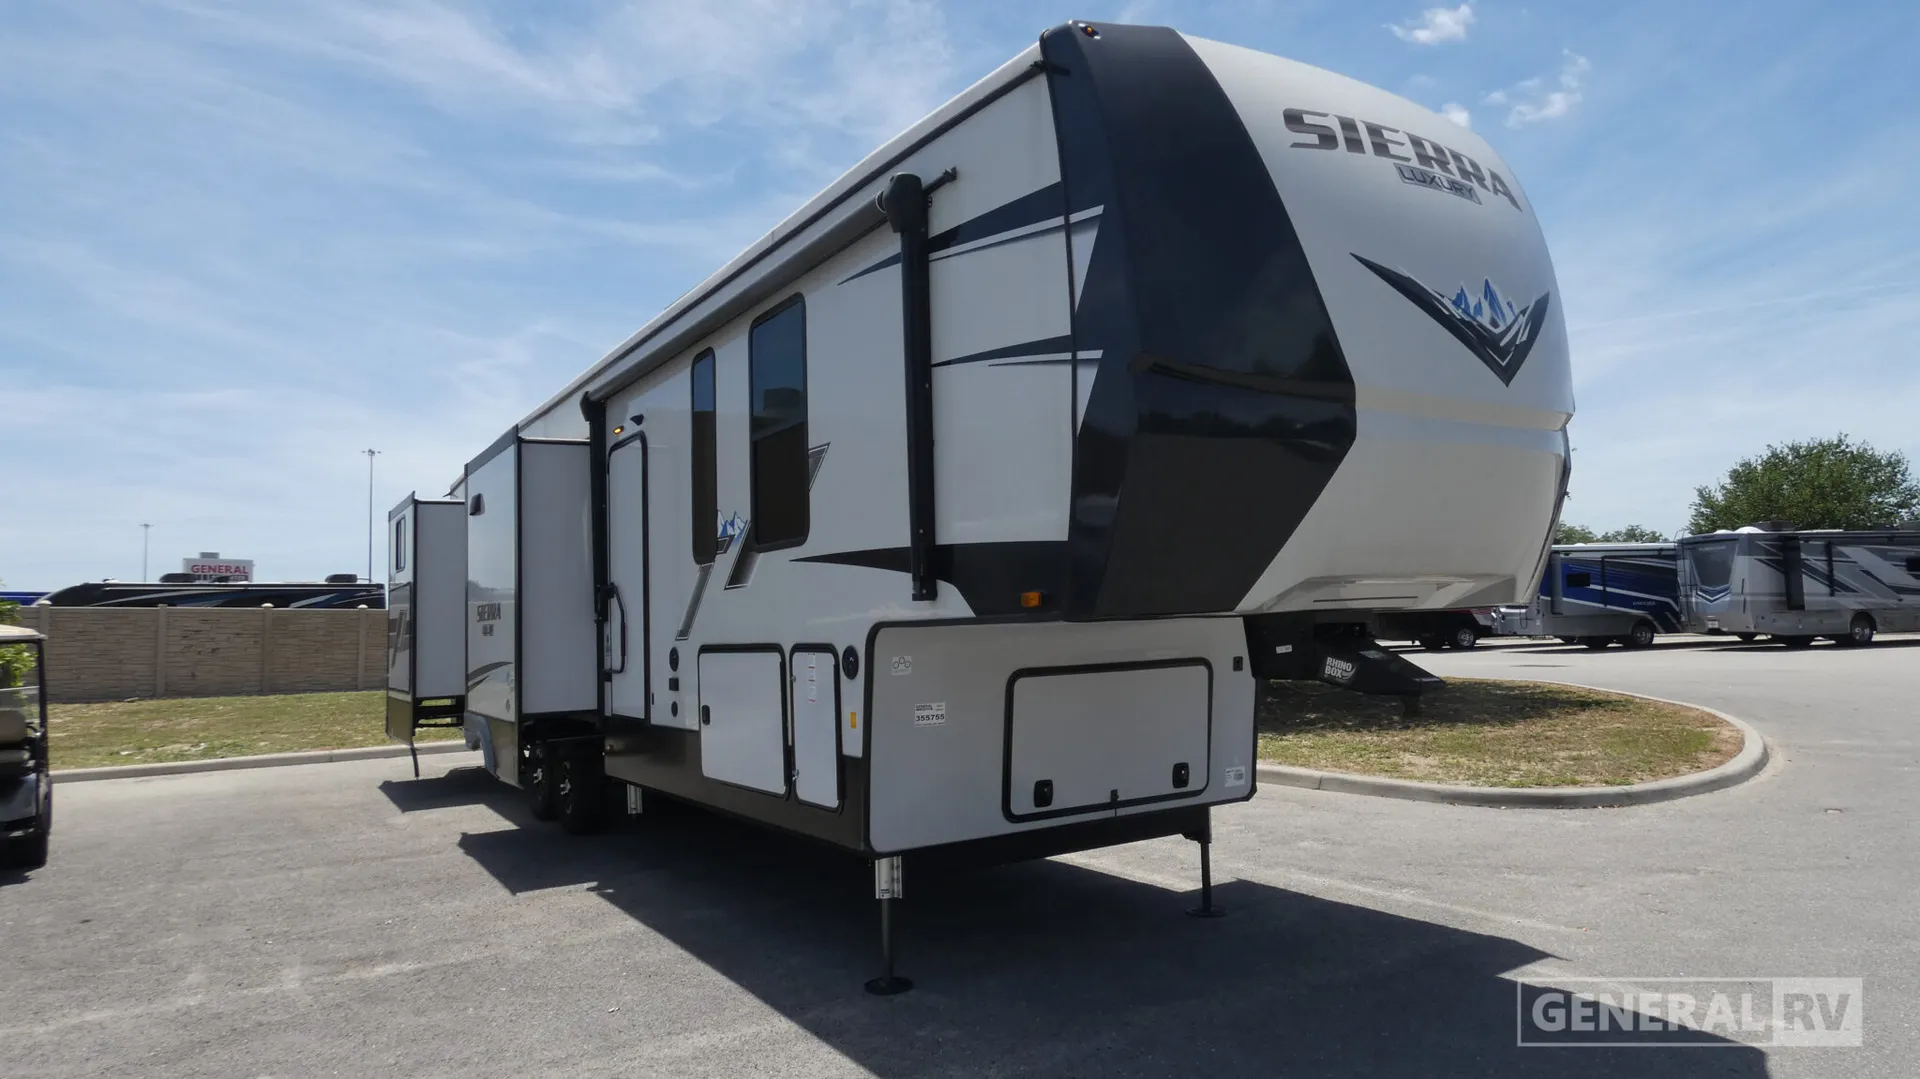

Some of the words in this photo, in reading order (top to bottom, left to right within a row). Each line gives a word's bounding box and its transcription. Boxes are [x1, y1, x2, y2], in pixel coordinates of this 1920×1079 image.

[1283, 108, 1523, 212] SIERRA
[1399, 168, 1475, 200] LUXURY
[191, 564, 249, 575] GENERAL
[1326, 656, 1352, 671] RHINO
[1325, 665, 1342, 678] BOX
[915, 713, 945, 722] 355755
